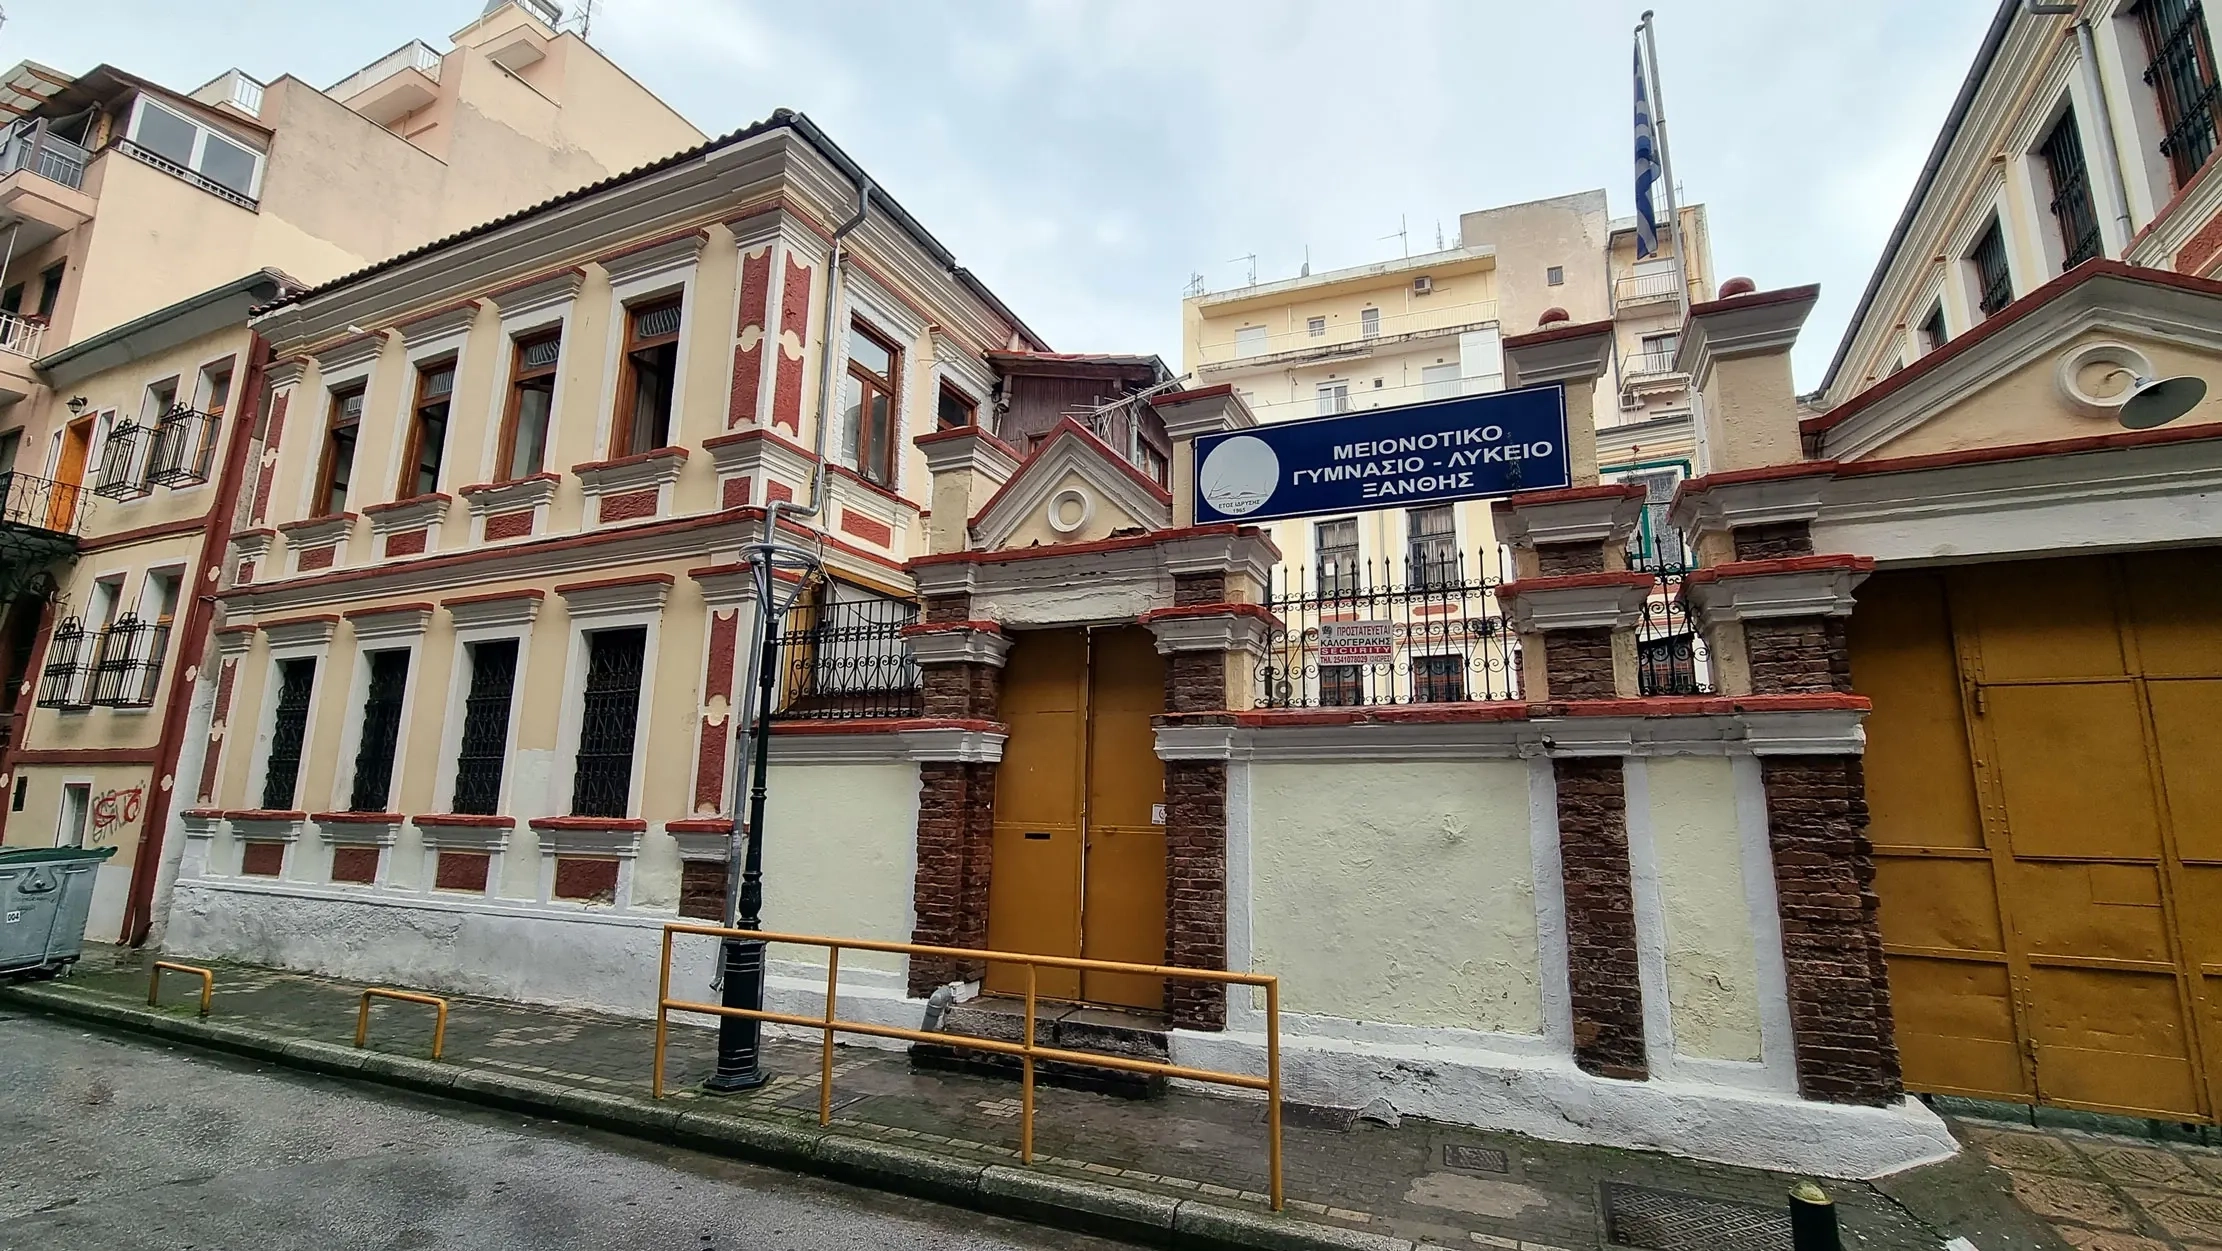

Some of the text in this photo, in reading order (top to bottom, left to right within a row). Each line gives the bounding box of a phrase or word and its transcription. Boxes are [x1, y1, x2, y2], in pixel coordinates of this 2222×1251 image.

[1333, 425, 1503, 461] ΜΕΙΟΝΟΤΙΚΟ
[1293, 456, 1425, 486] ΓΥΜΝΑΣΙΟ
[1447, 441, 1553, 468] ΛΥΚΕΙΟ
[1362, 471, 1475, 498] ΞΑΝΘΗΣ
[1337, 625, 1390, 636] ΠΡΟΣΤΑΤΕΥΕΤΑΙ
[1320, 637, 1391, 647] ΚΑΛΟΓΕΡΑΚΗΣ
[1321, 646, 1390, 655] SECURITY
